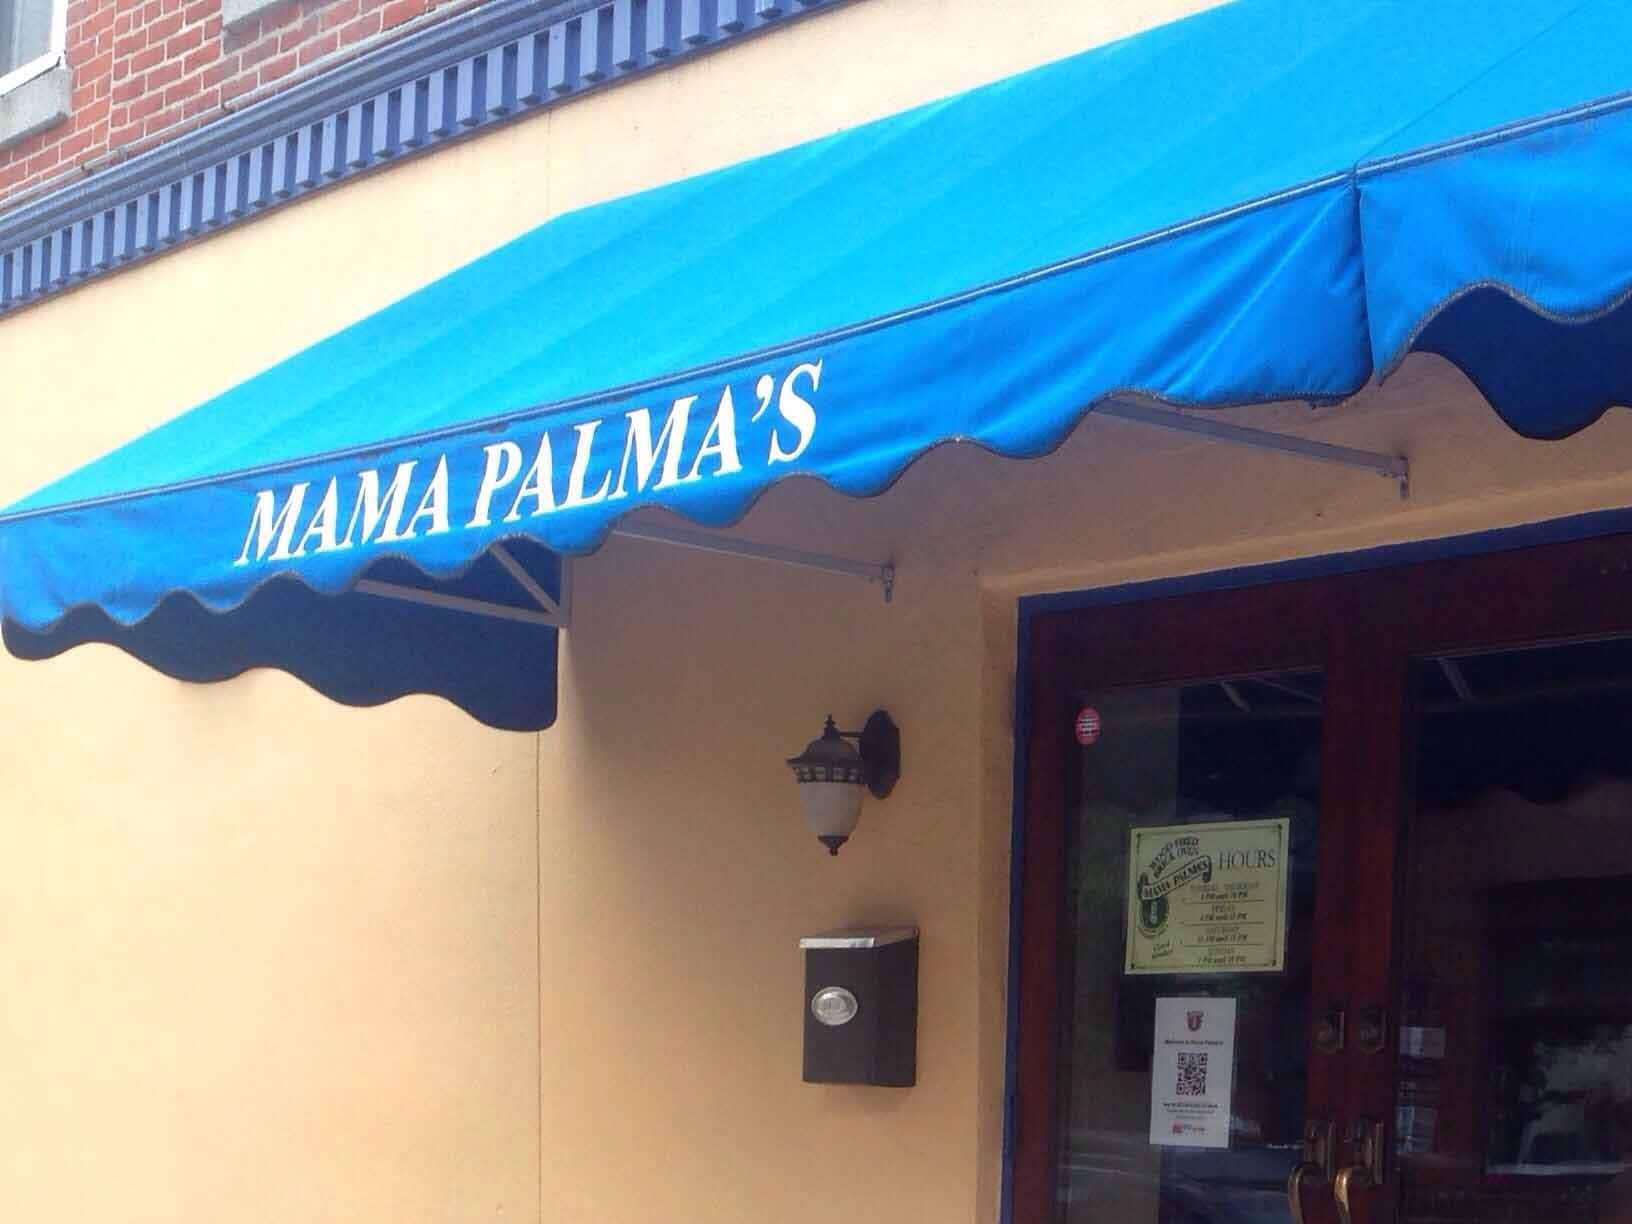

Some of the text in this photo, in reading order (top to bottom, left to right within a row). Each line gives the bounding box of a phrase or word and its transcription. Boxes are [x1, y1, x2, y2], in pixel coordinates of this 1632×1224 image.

[234, 359, 824, 567] MAMA PALMA'S
[1219, 849, 1277, 870] HOURS
